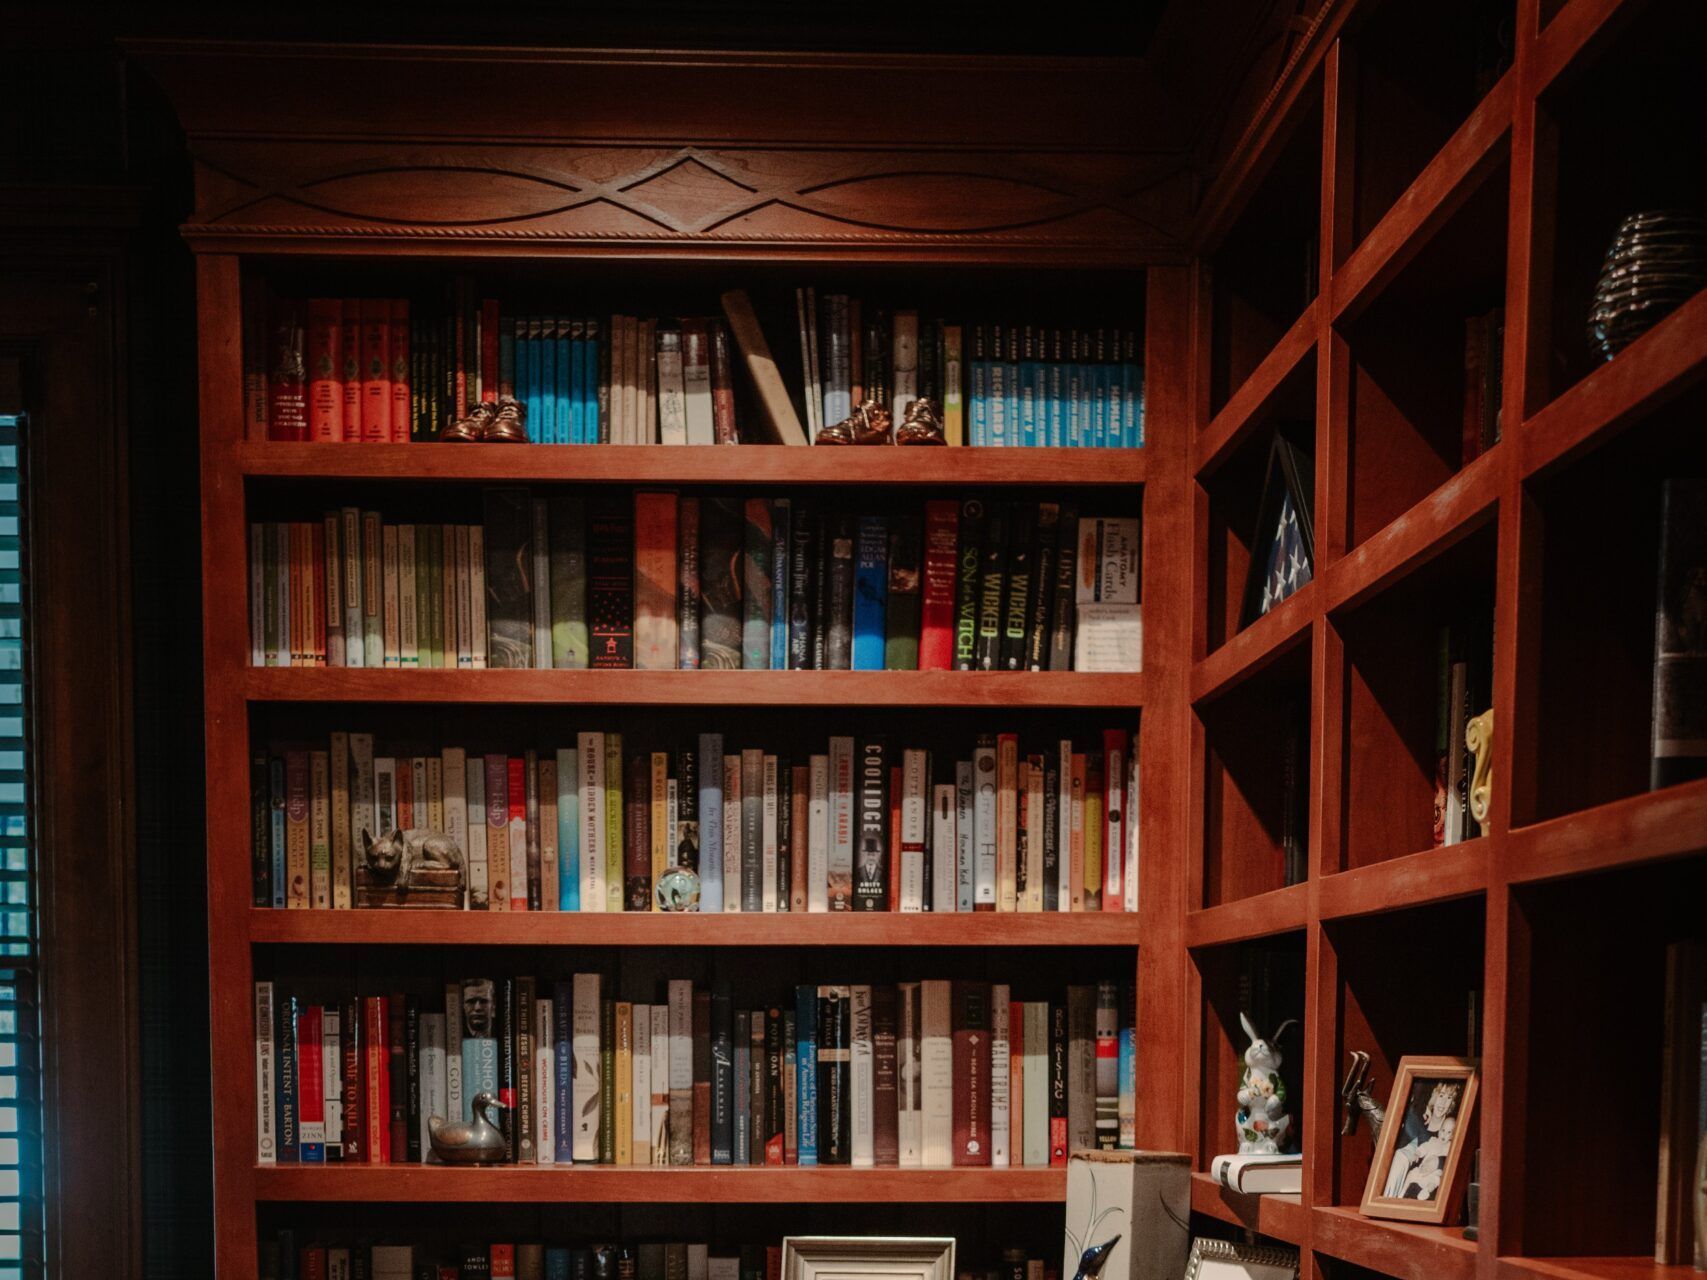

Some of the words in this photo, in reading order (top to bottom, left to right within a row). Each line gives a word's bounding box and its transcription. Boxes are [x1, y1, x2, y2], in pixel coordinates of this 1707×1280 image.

[1024, 387, 1032, 422] HENRY
[1110, 385, 1120, 435] HAMLET
[1024, 425, 1032, 433] V
[1106, 523, 1119, 558] Flash
[962, 547, 979, 582] SON
[1119, 537, 1127, 587] ANATOMY
[1103, 561, 1118, 600] Cards
[980, 573, 1003, 638] WICKED
[1006, 574, 1029, 639] WICKED
[798, 632, 807, 662] SHANA
[957, 602, 976, 660] WITCH
[586, 747, 596, 775] HOUSE
[839, 753, 848, 795] LAWRENCE
[586, 781, 595, 813] HIDDEN
[863, 744, 882, 833] COOLIDGE
[1046, 769, 1056, 798] Kurt
[910, 767, 918, 838] OUTLANDER
[959, 788, 971, 820] Dinner
[587, 816, 596, 854] MOTHERS
[635, 811, 643, 862] HEMINGWAY
[839, 813, 848, 845] ARABIA
[960, 834, 969, 866] Herman
[959, 868, 969, 886] Koch
[281, 1001, 291, 1053] ORIGINAL
[282, 1055, 292, 1095] INTENT
[346, 1050, 356, 1081] TIME
[769, 1052, 778, 1077] JOAN
[807, 1045, 817, 1081] Emergence
[1054, 1043, 1063, 1100] RISING
[346, 1083, 356, 1100] TO
[449, 1067, 460, 1101] GOD
[801, 1066, 810, 1100] American
[346, 1103, 357, 1130] KILL
[521, 1104, 529, 1134] CHOPRA
[542, 1106, 548, 1118] ON
[799, 1101, 810, 1133] Religious
[809, 1091, 817, 1123] Christian
[283, 1104, 293, 1146] BARTON
[801, 1133, 810, 1147] Life
[809, 1123, 817, 1148] Science
[1012, 1266, 1021, 1280] SO
